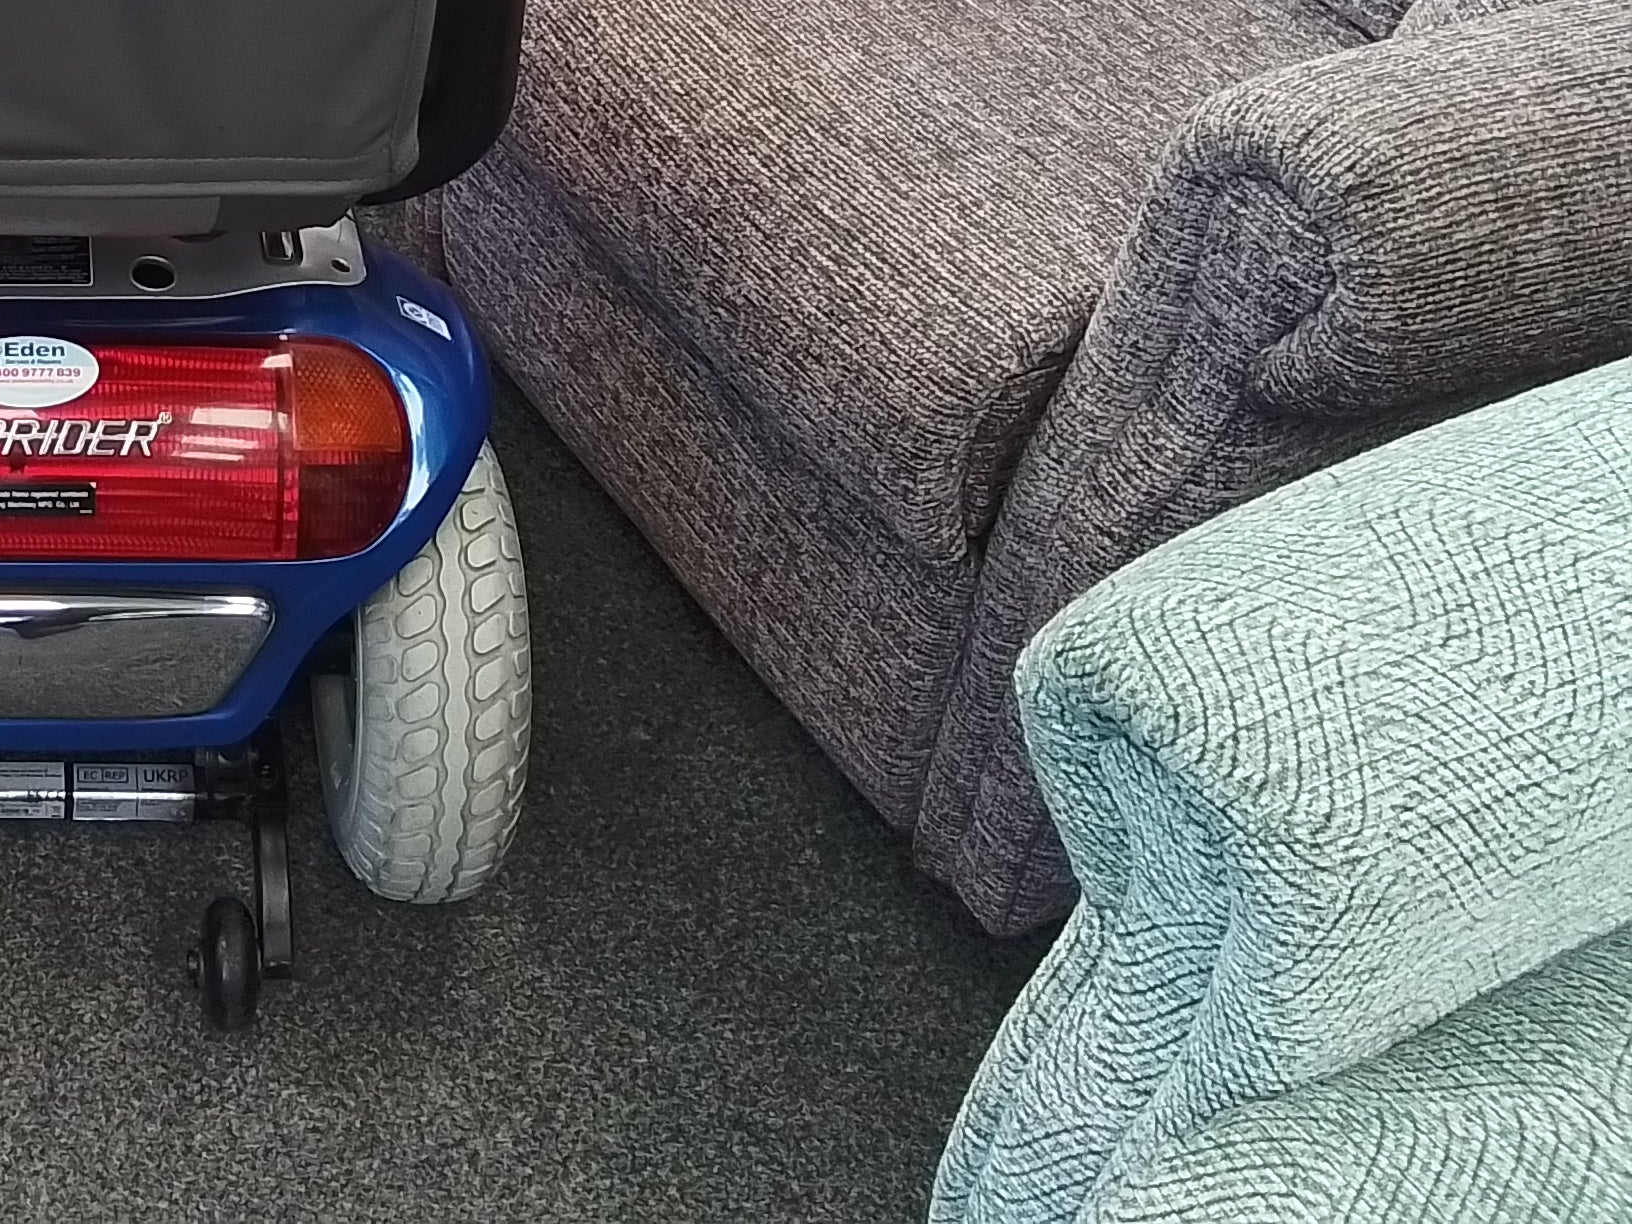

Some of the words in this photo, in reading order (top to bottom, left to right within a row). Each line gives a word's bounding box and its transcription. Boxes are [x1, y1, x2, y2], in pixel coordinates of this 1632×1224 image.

[4, 341, 66, 357] Eden
[21, 367, 54, 377] 9777
[83, 770, 98, 780] EC
[142, 768, 189, 783] UKRP
